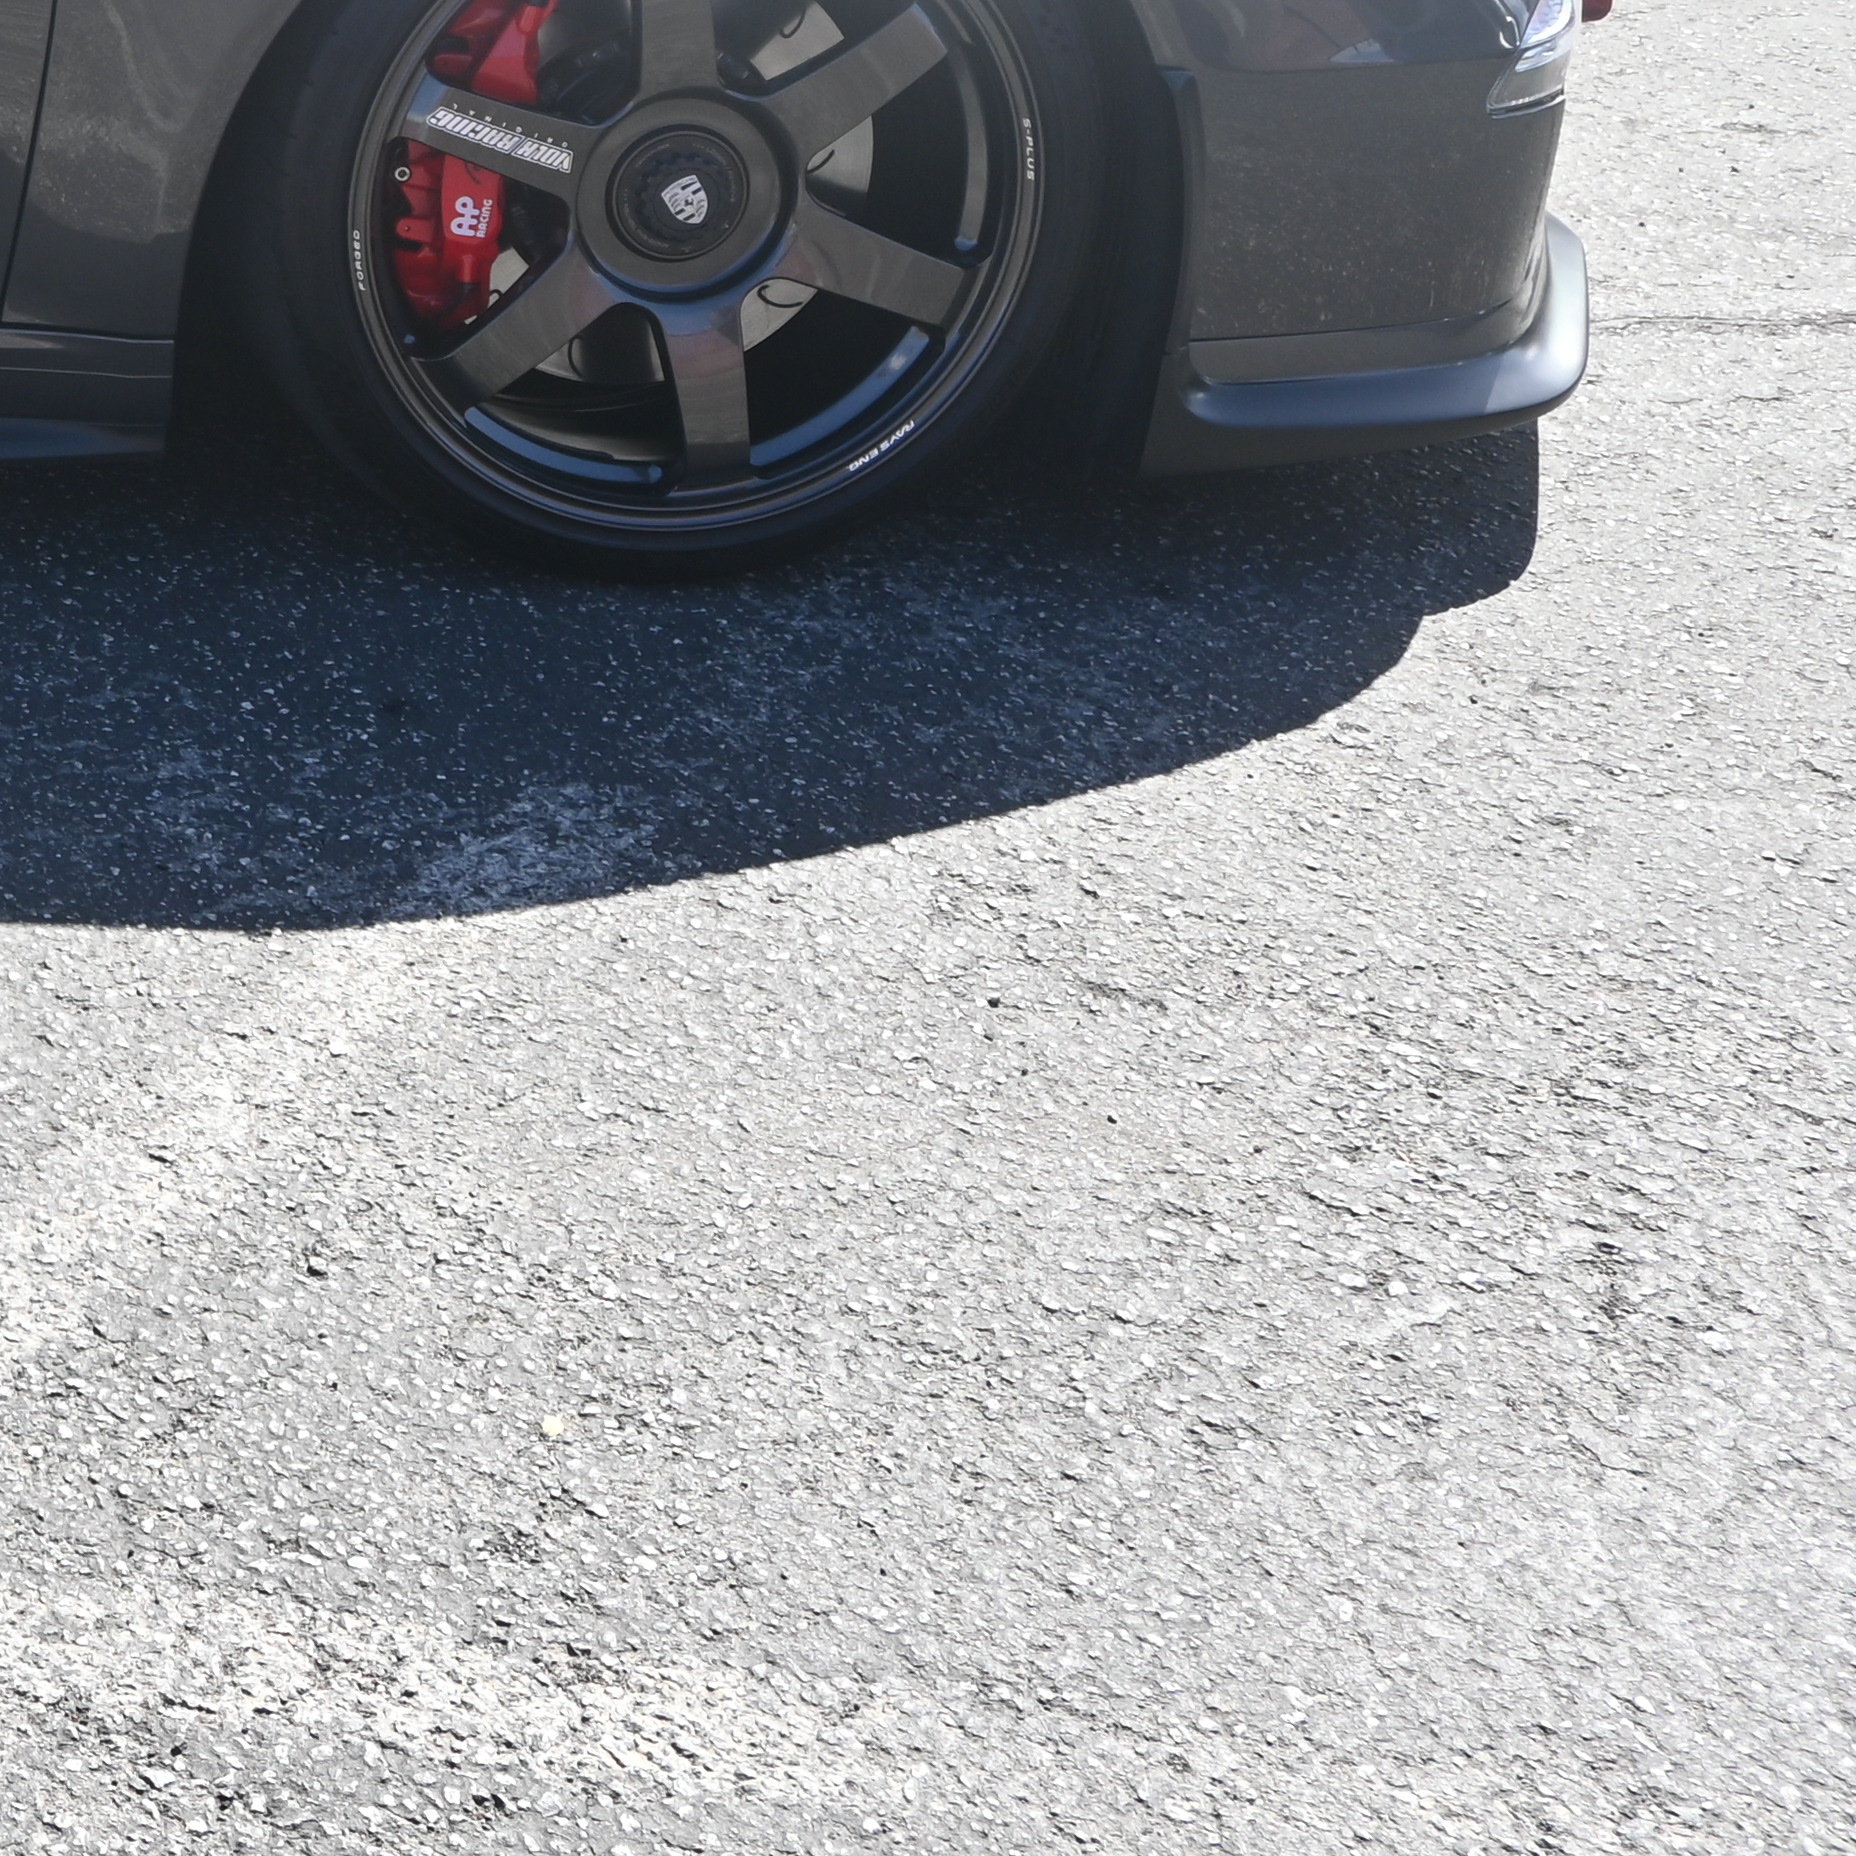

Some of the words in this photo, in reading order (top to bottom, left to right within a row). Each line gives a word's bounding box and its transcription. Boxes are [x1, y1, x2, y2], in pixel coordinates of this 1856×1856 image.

[426, 106, 526, 154] RACING
[511, 137, 574, 174] VOLK
[476, 199, 493, 238] RACING
[353, 230, 367, 291] FORGED
[880, 419, 915, 452] RAYS
